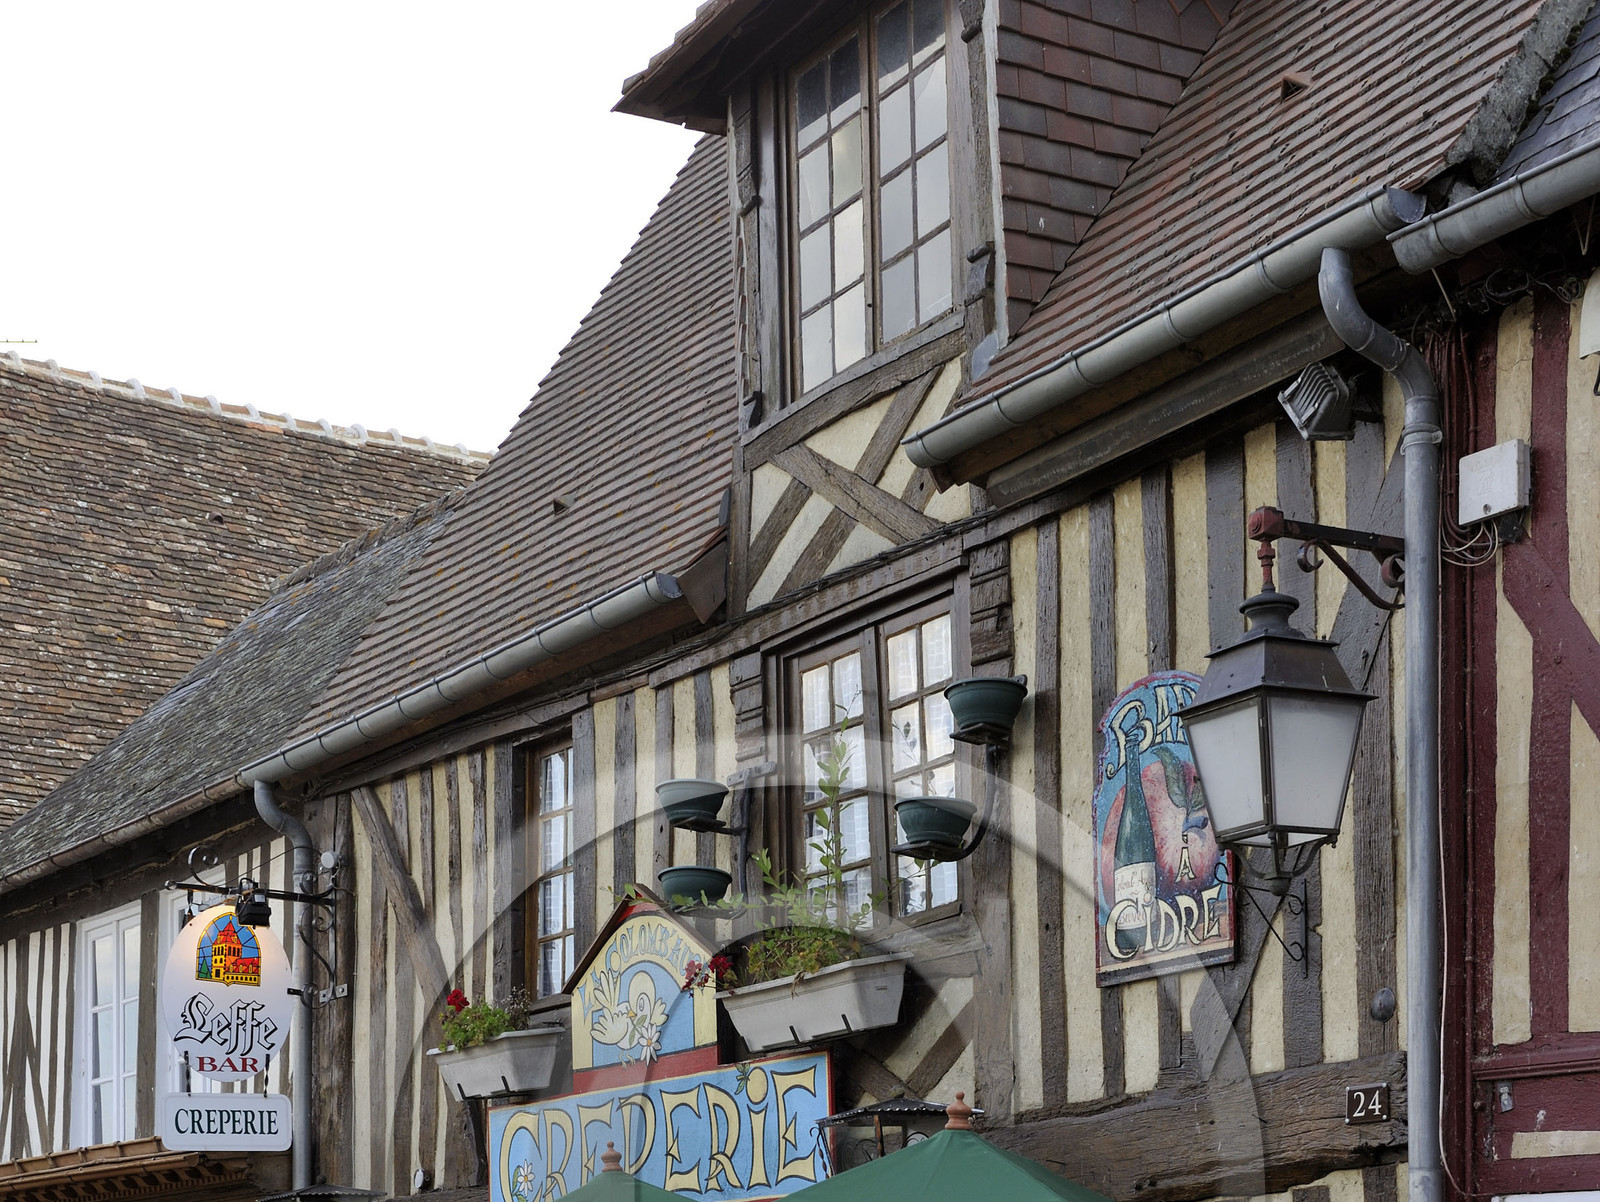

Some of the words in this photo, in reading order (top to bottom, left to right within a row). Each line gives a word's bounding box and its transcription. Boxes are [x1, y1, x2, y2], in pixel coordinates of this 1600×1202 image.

[1104, 883, 1223, 961] CIDRE
[604, 921, 712, 996] COLOMB'AU
[173, 992, 279, 1057] Leffe
[196, 1056, 258, 1073] BAR
[174, 1108, 279, 1136] CREPERIE
[1352, 1089, 1383, 1118] 24
